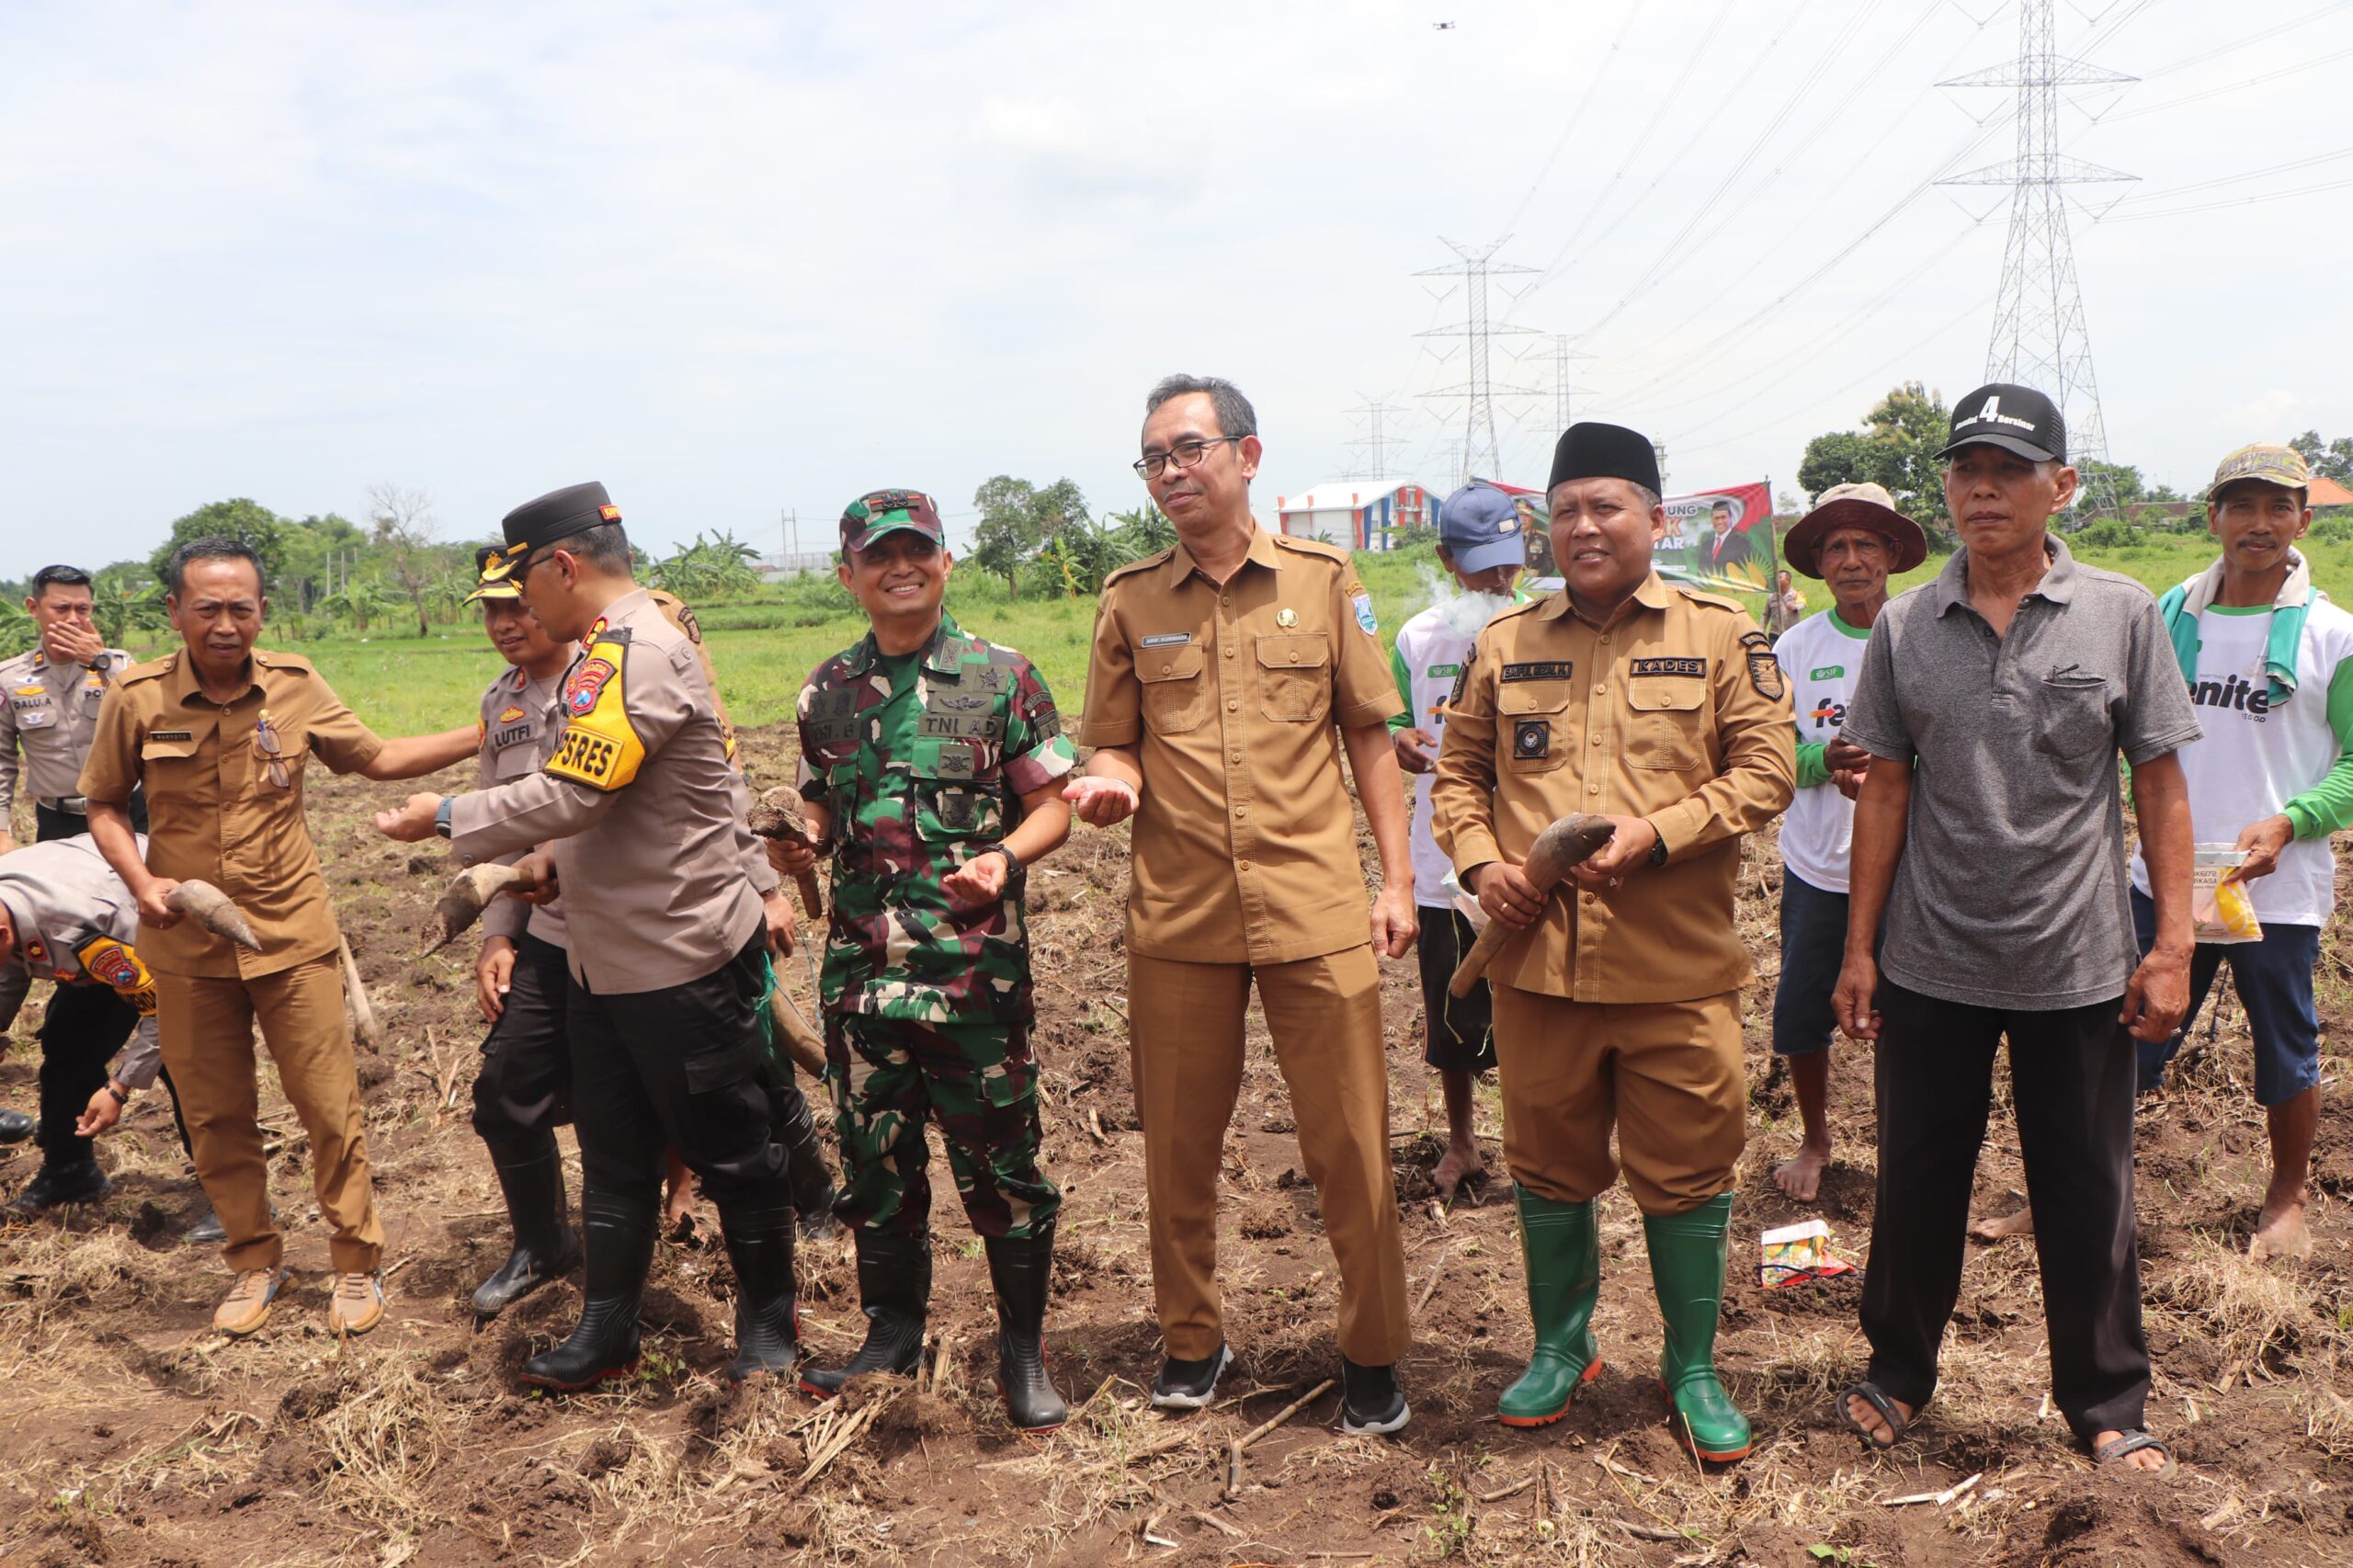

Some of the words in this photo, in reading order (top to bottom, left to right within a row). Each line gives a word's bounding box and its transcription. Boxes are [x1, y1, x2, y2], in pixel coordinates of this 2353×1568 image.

[1979, 396, 2000, 422] 4
[1997, 415, 2036, 432] Bersinar
[1665, 506, 1698, 515] UNG
[1504, 665, 1533, 679] SAIFUL
[1638, 660, 1699, 673] KADES
[84, 689, 104, 699] PO
[926, 717, 959, 734] TNI
[968, 719, 997, 735] AD
[494, 724, 530, 747] LUTFI
[552, 733, 613, 777] PSRES
